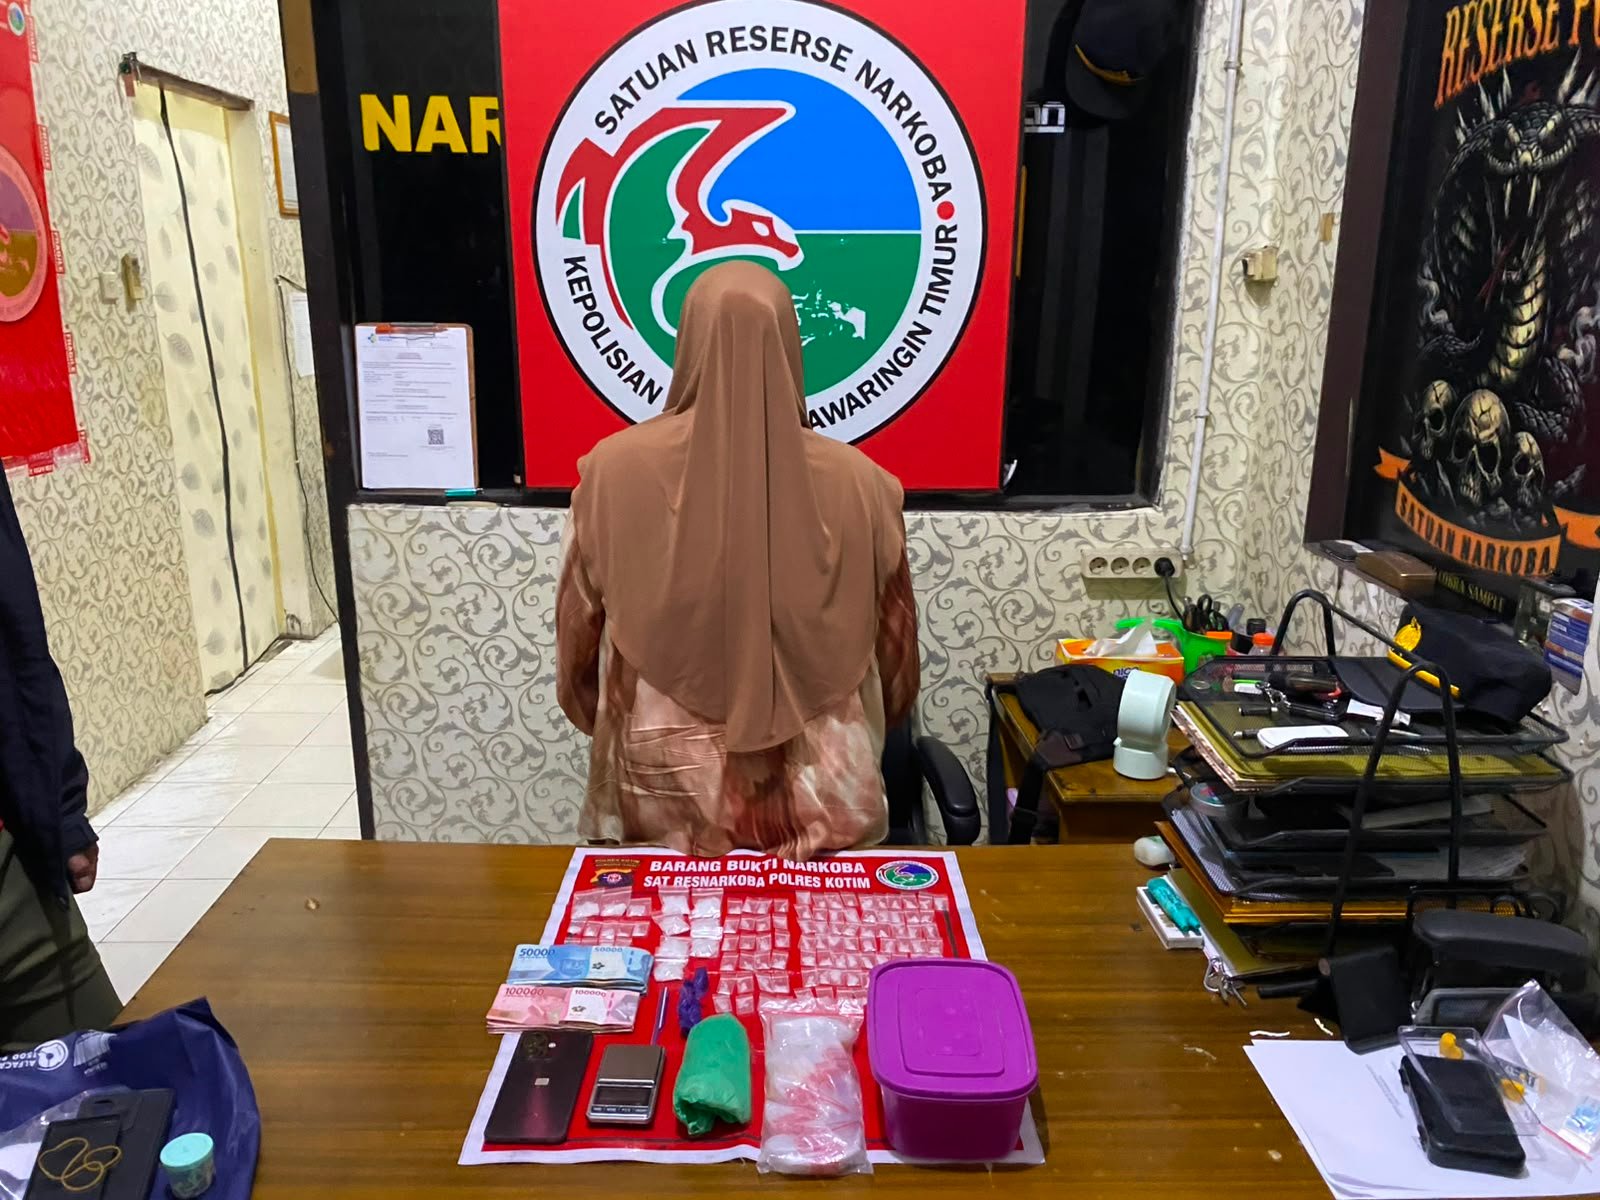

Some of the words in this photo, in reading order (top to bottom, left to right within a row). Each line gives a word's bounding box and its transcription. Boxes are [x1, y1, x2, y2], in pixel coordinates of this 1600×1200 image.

[595, 39, 697, 134] SATUAN
[705, 25, 853, 73] RESERSE
[854, 59, 952, 202] NARKOBA
[919, 224, 958, 315] TIMUR
[563, 255, 663, 404] KEPOLISIAN
[1400, 492, 1455, 552] SATUAN
[1460, 534, 1552, 574] NARKOBA
[643, 875, 671, 888] SAT
[673, 874, 765, 889] RESNARKOBA
[769, 873, 822, 888] POLRES
[825, 877, 871, 889] KOTIM
[649, 860, 721, 873] BARANG
[727, 858, 778, 873] BUKTI
[784, 858, 866, 874] NARKOBA
[518, 947, 555, 957] 50000
